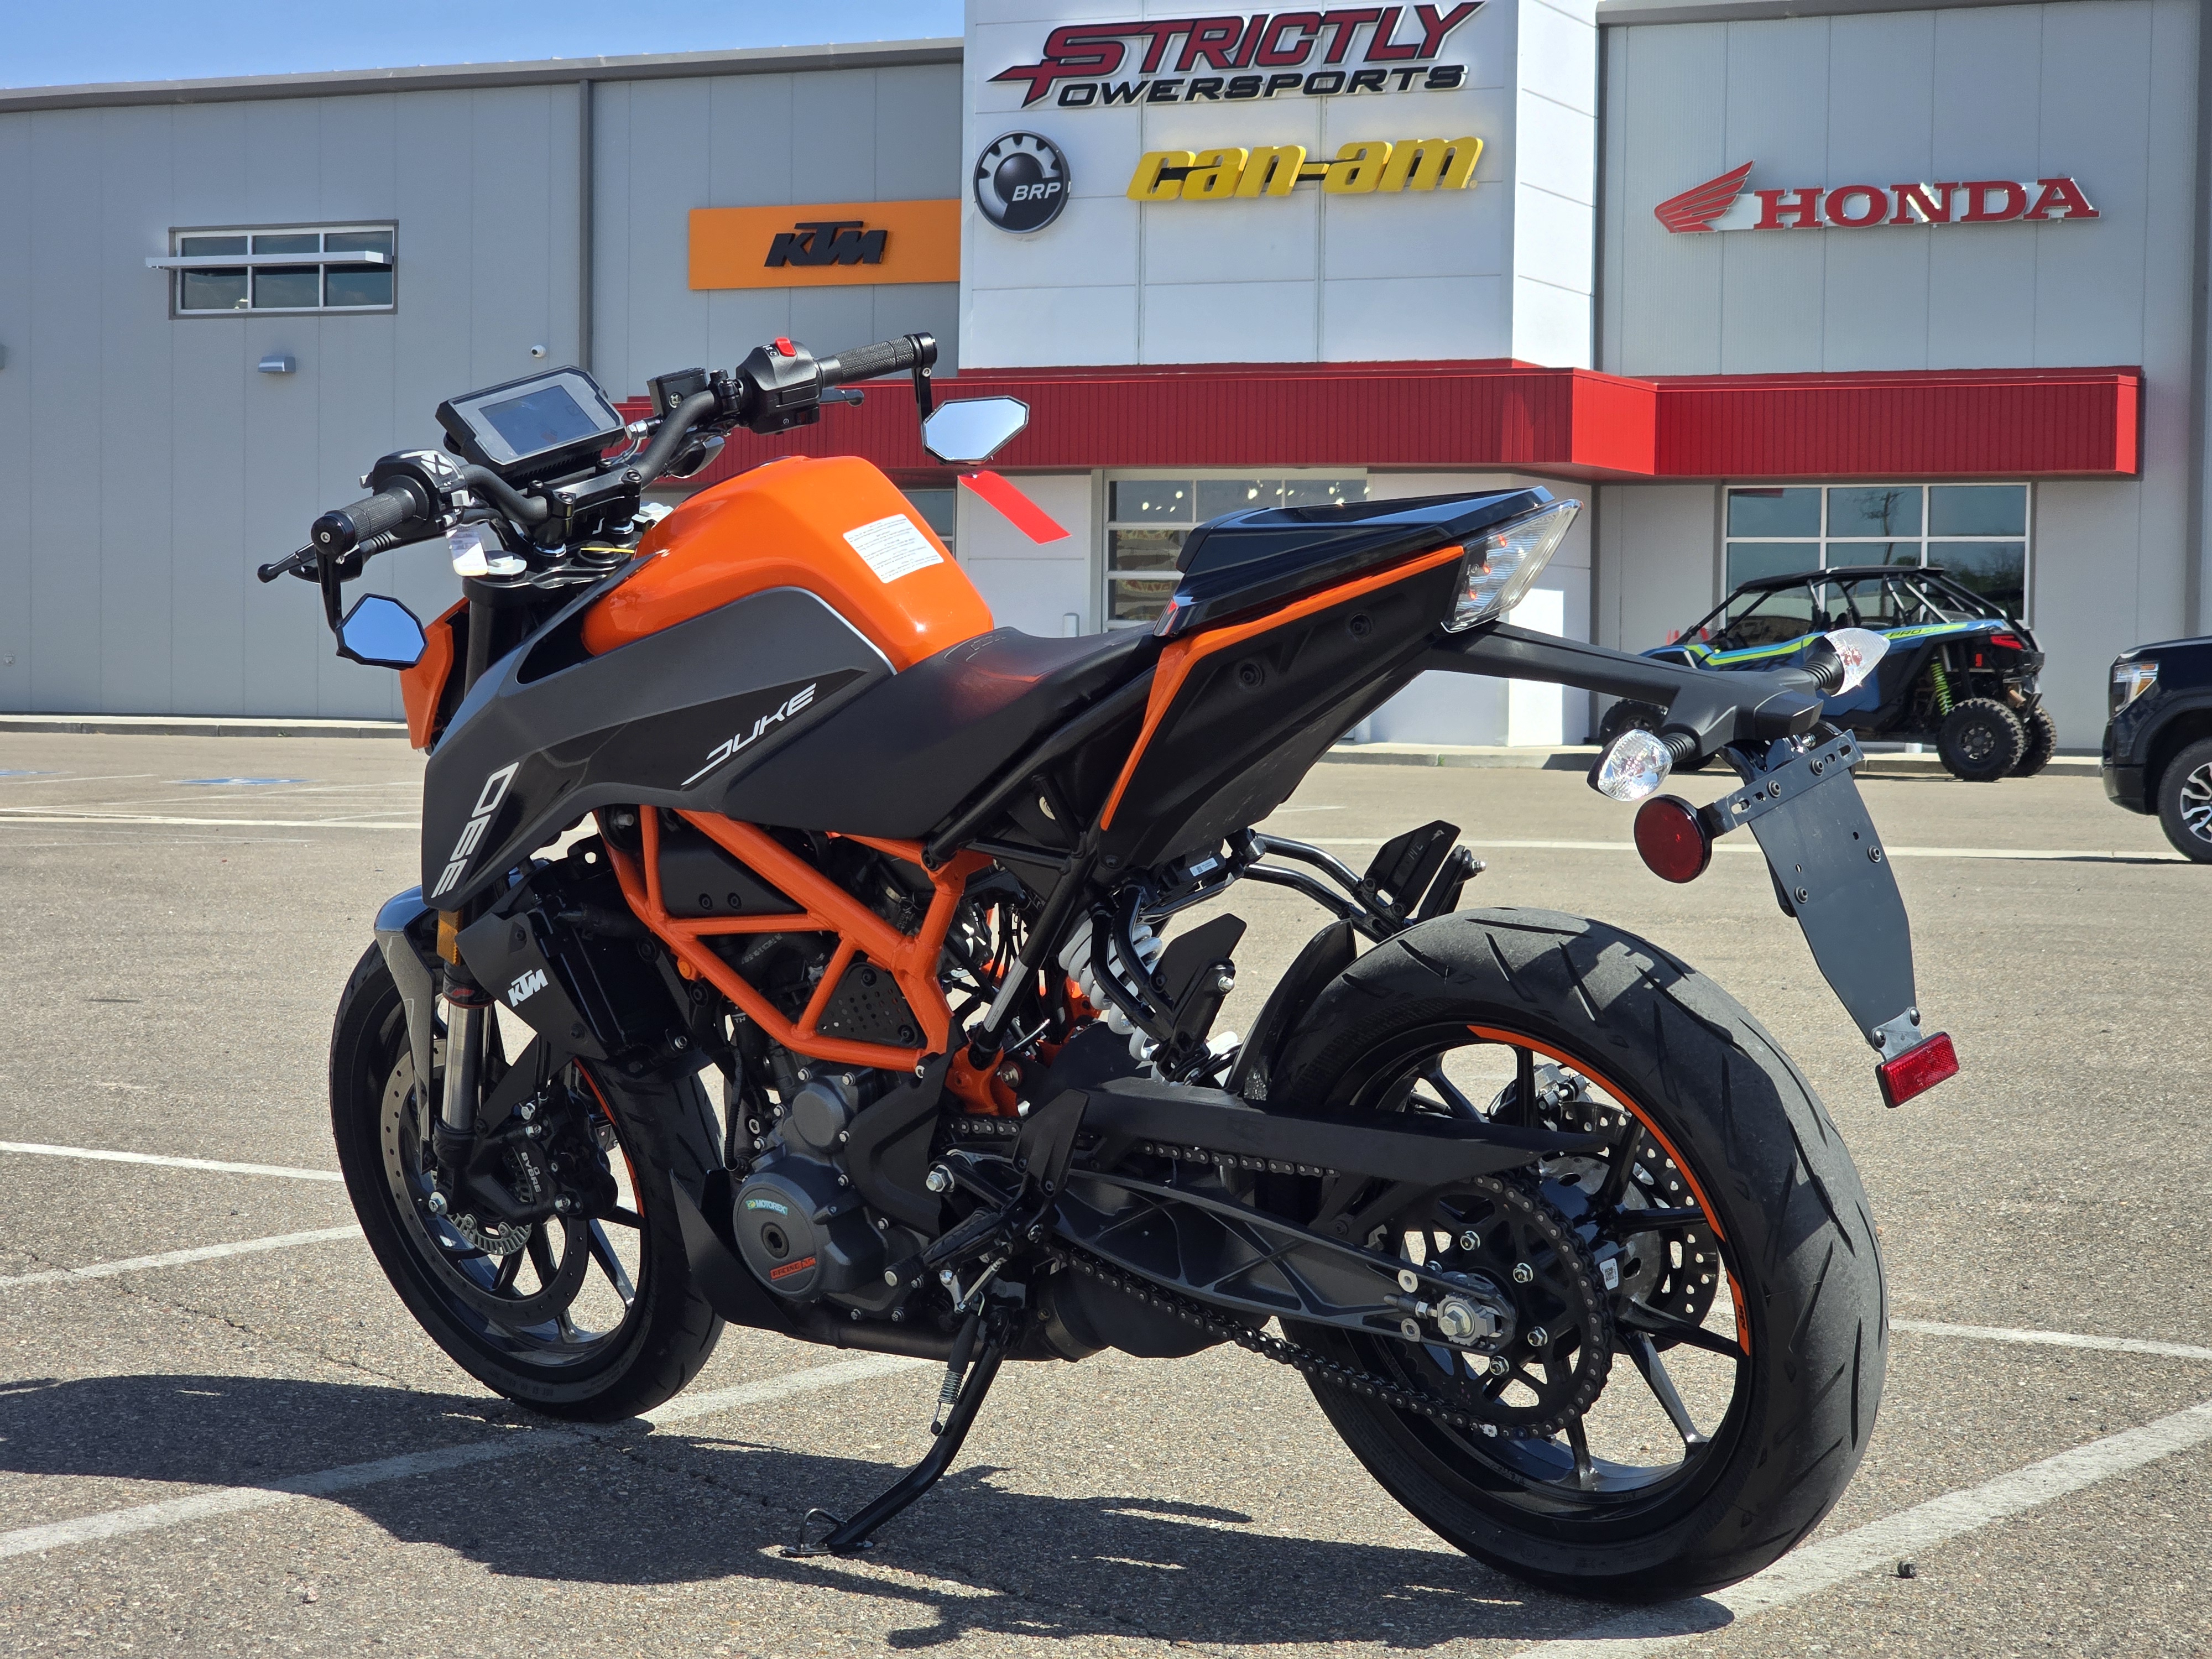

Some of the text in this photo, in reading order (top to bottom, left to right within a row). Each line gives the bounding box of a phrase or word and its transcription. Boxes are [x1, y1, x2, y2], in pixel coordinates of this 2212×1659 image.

[987, 1, 1486, 82] STRICTLY
[1012, 182, 1061, 201] BRP
[1126, 137, 1483, 201] can-am
[1754, 177, 2100, 231] HONDA
[764, 221, 888, 267] KTM
[1889, 629, 1922, 638] PRO
[680, 682, 817, 786] DUKE
[431, 761, 519, 899] 390
[508, 968, 549, 1007] KTM
[521, 1152, 541, 1193] BYBRE
[755, 1199, 787, 1214] MOTOREX
